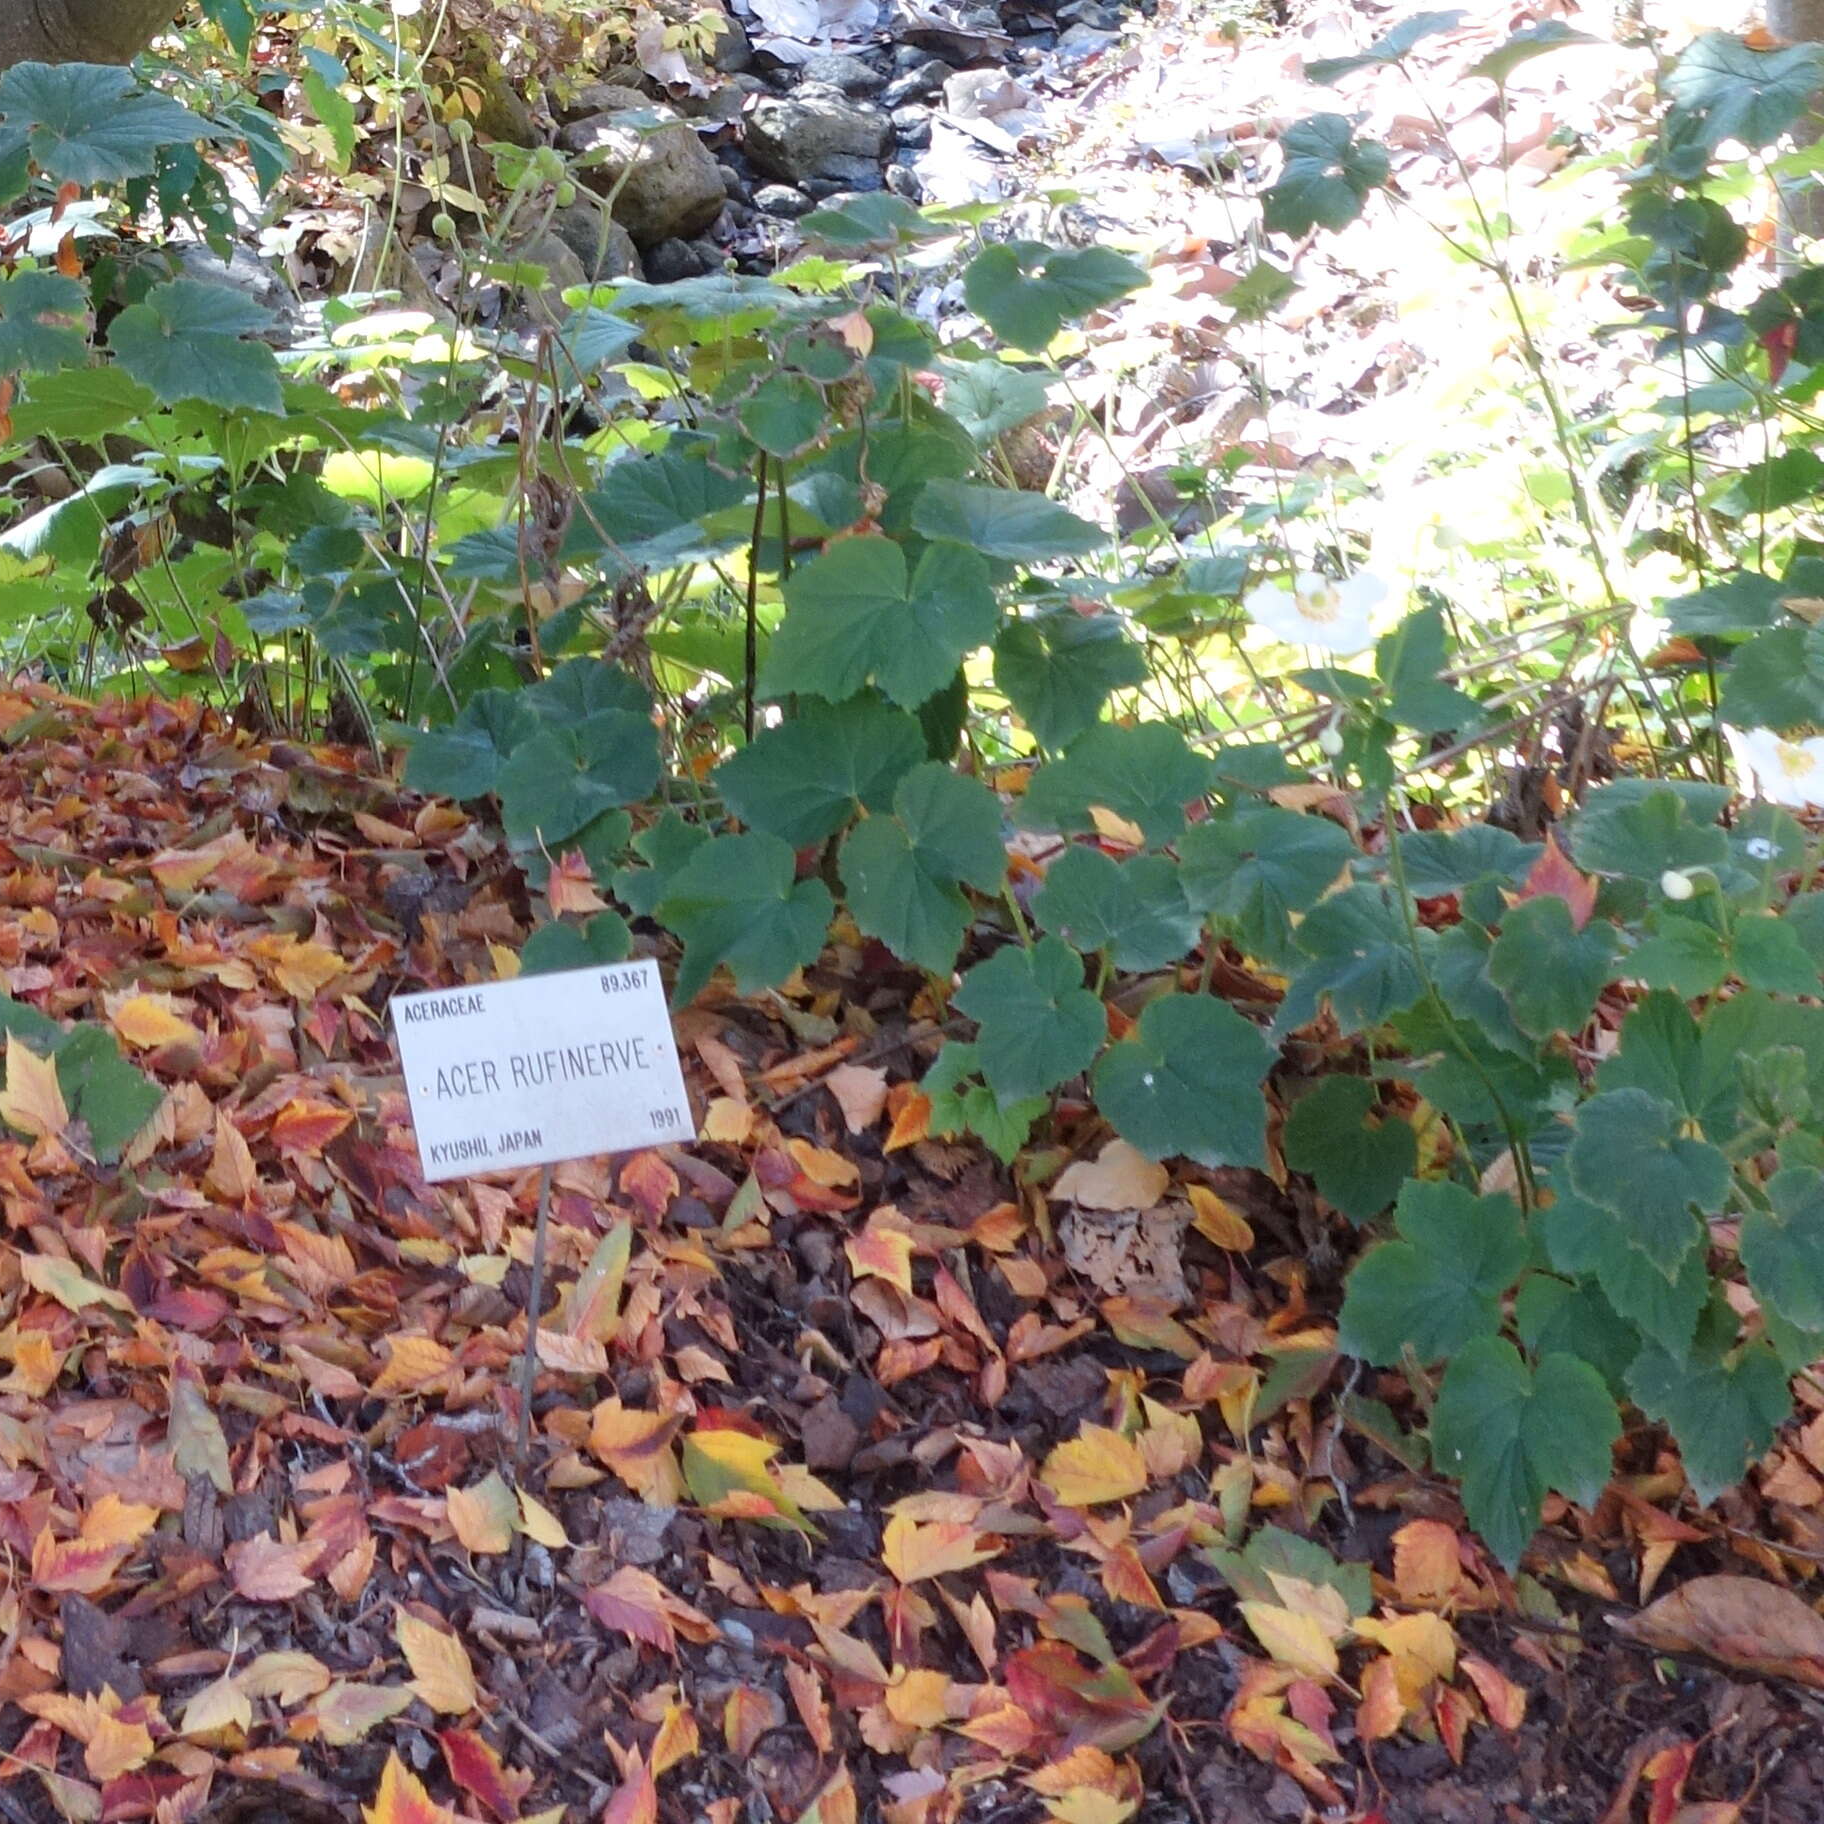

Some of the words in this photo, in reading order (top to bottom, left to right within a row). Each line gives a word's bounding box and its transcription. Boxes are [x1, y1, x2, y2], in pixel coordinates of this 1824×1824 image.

[600, 969, 649, 994] 89.367
[404, 993, 486, 1024] ACERACEAE
[437, 1059, 501, 1100] ACER
[510, 1037, 650, 1089] RUFINERVE
[649, 1107, 681, 1129] 1991
[430, 1136, 493, 1164] KYUSHU,
[498, 1128, 543, 1153] JAPAN
